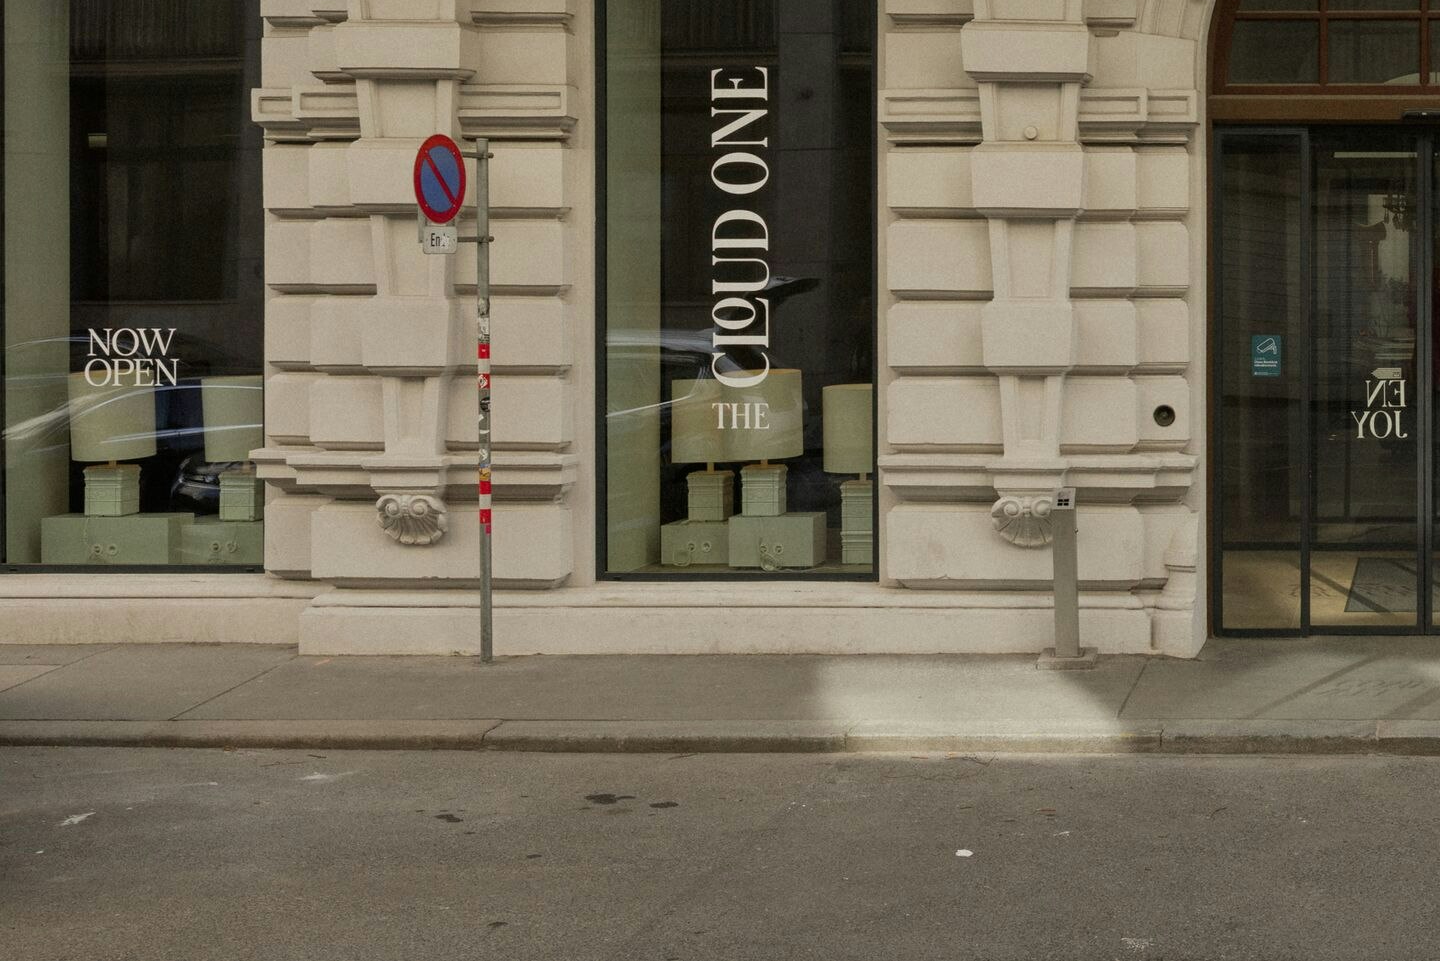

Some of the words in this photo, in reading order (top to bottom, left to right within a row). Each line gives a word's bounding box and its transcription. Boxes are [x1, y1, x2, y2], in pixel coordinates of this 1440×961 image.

[711, 66, 769, 195] ONE
[711, 209, 770, 388] CLOUD
[87, 327, 177, 357] NOW
[84, 357, 179, 387] OPEN
[712, 402, 770, 430] THE
